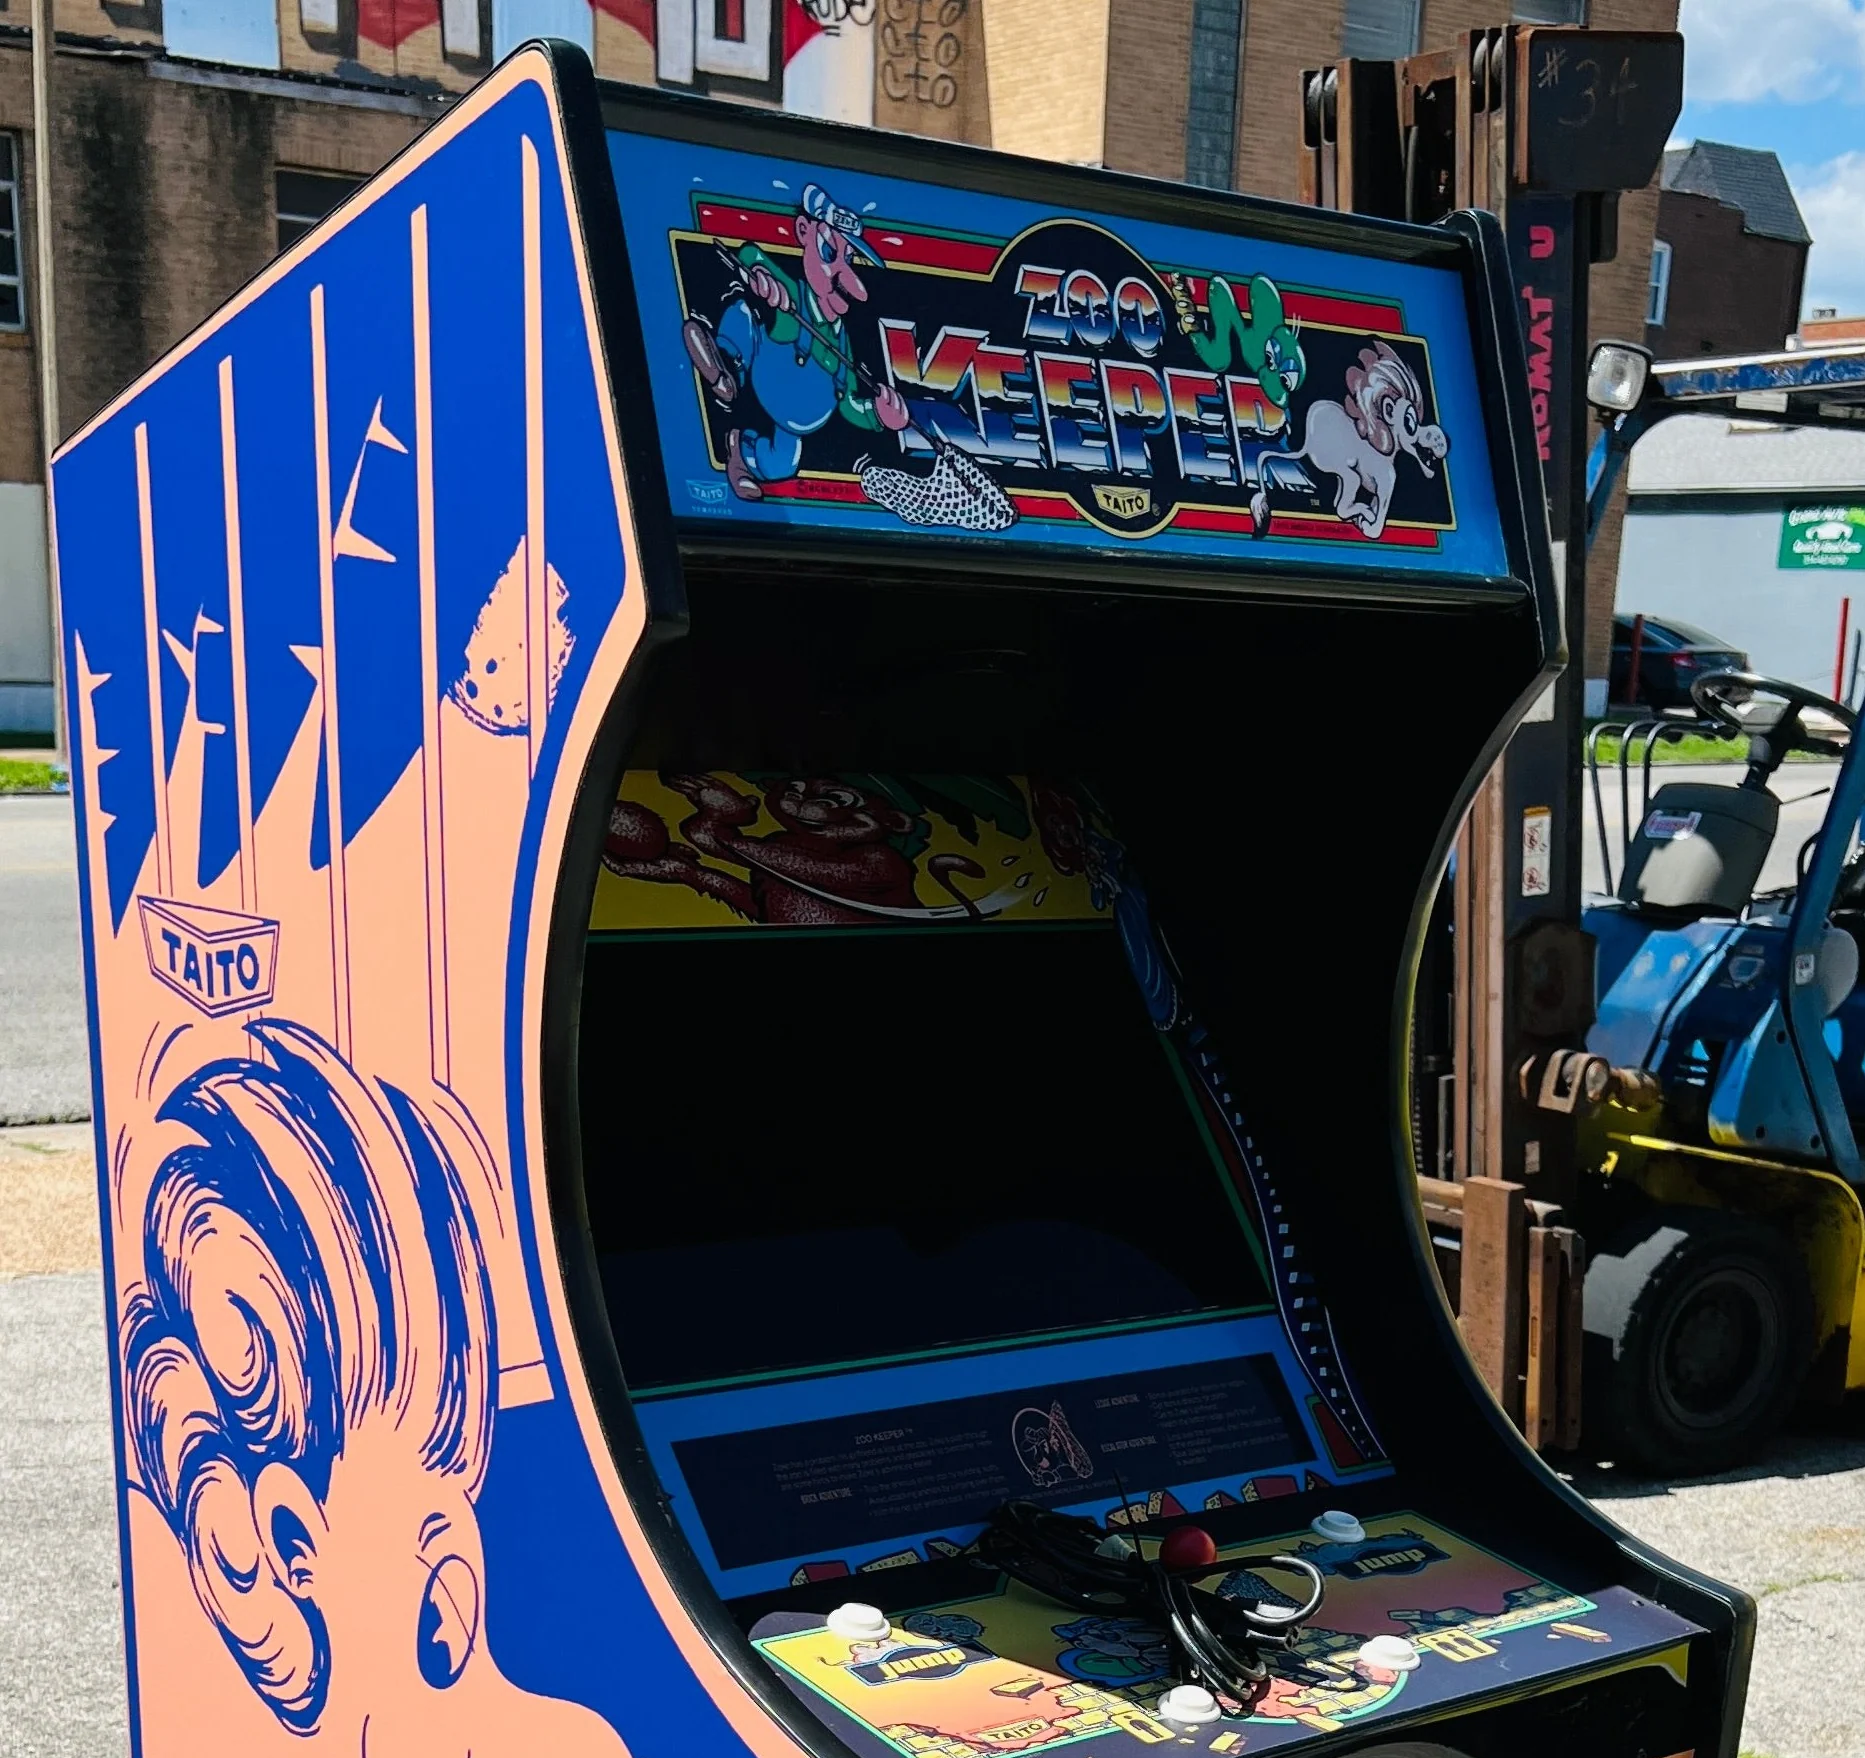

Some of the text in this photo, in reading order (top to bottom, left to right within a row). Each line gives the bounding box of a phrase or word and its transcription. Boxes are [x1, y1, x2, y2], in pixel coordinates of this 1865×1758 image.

[1015, 264, 1166, 357] ZOO
[879, 318, 1317, 492] KEEPER
[694, 487, 723, 499] TAITO
[1103, 493, 1145, 514] TAITO
[162, 927, 260, 998] TAITO
[988, 1723, 1043, 1740] TAITO
